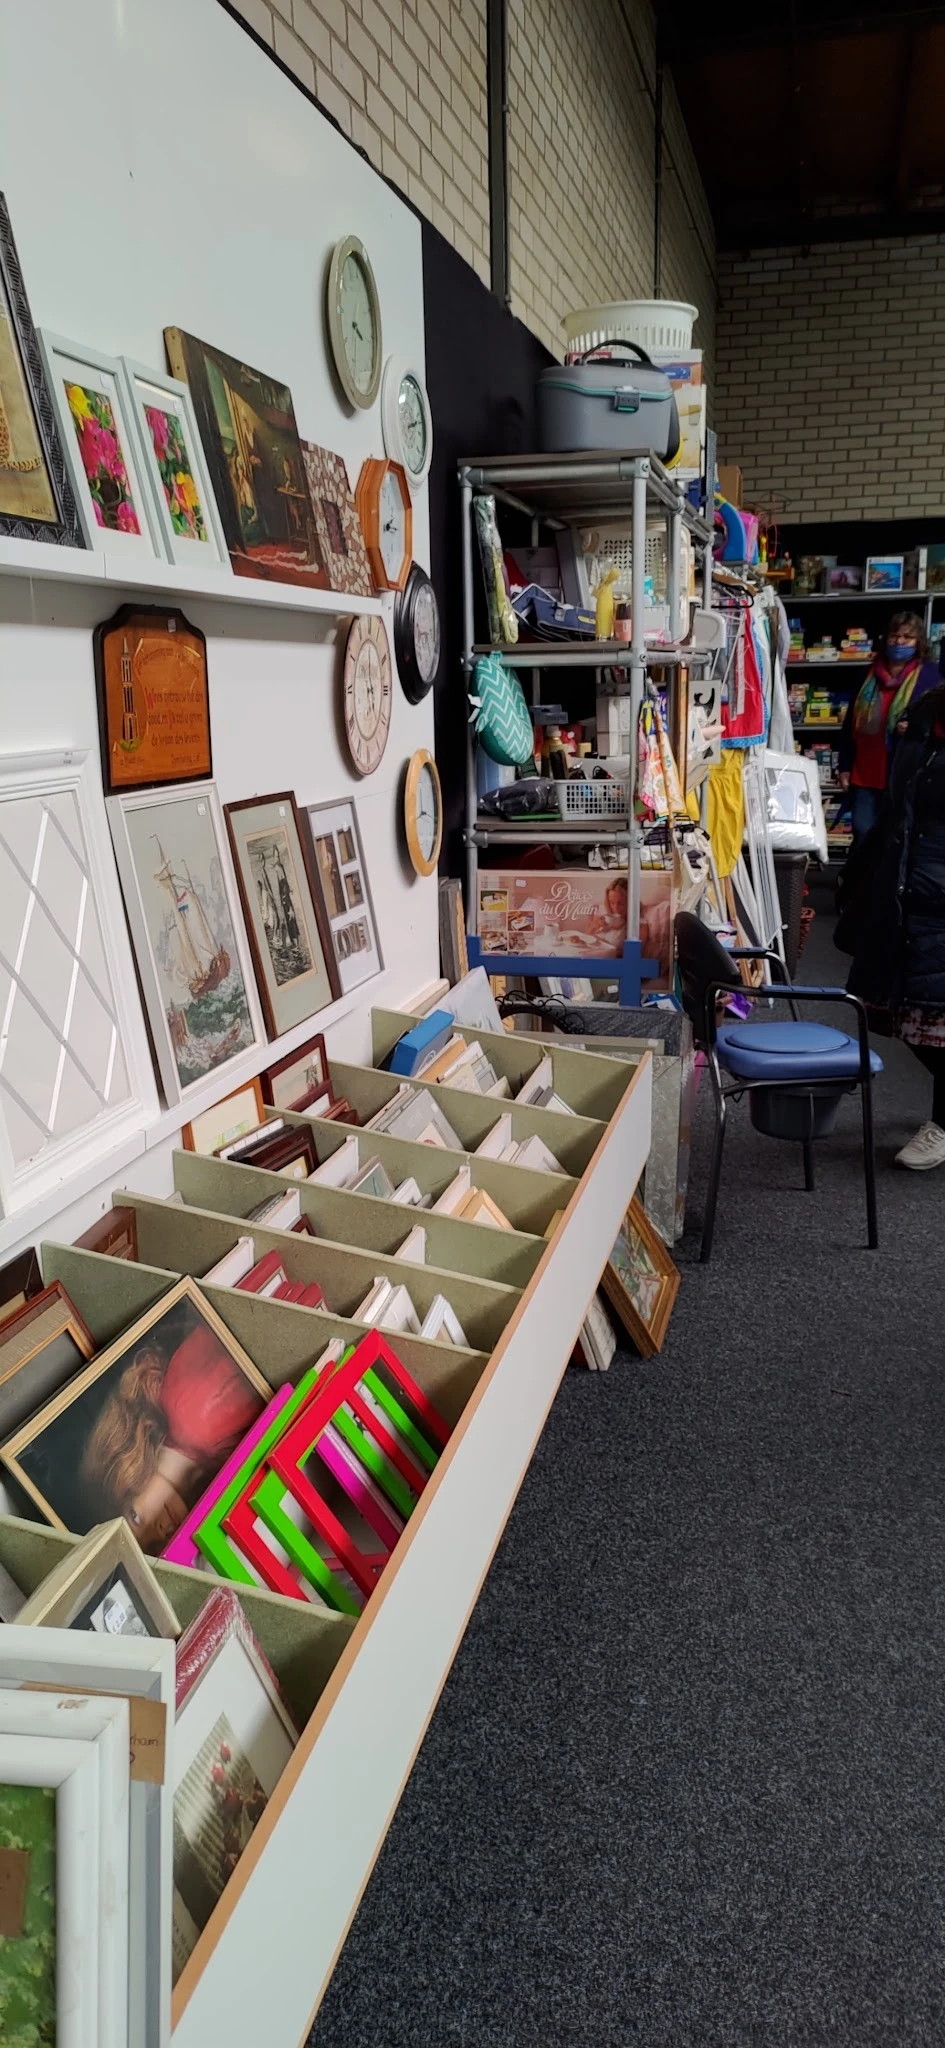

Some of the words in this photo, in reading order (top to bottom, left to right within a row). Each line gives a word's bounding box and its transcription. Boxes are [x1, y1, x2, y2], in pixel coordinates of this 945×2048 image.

[544, 881, 593, 901] Délices
[540, 902, 553, 915] du
[546, 900, 598, 921] Matin
